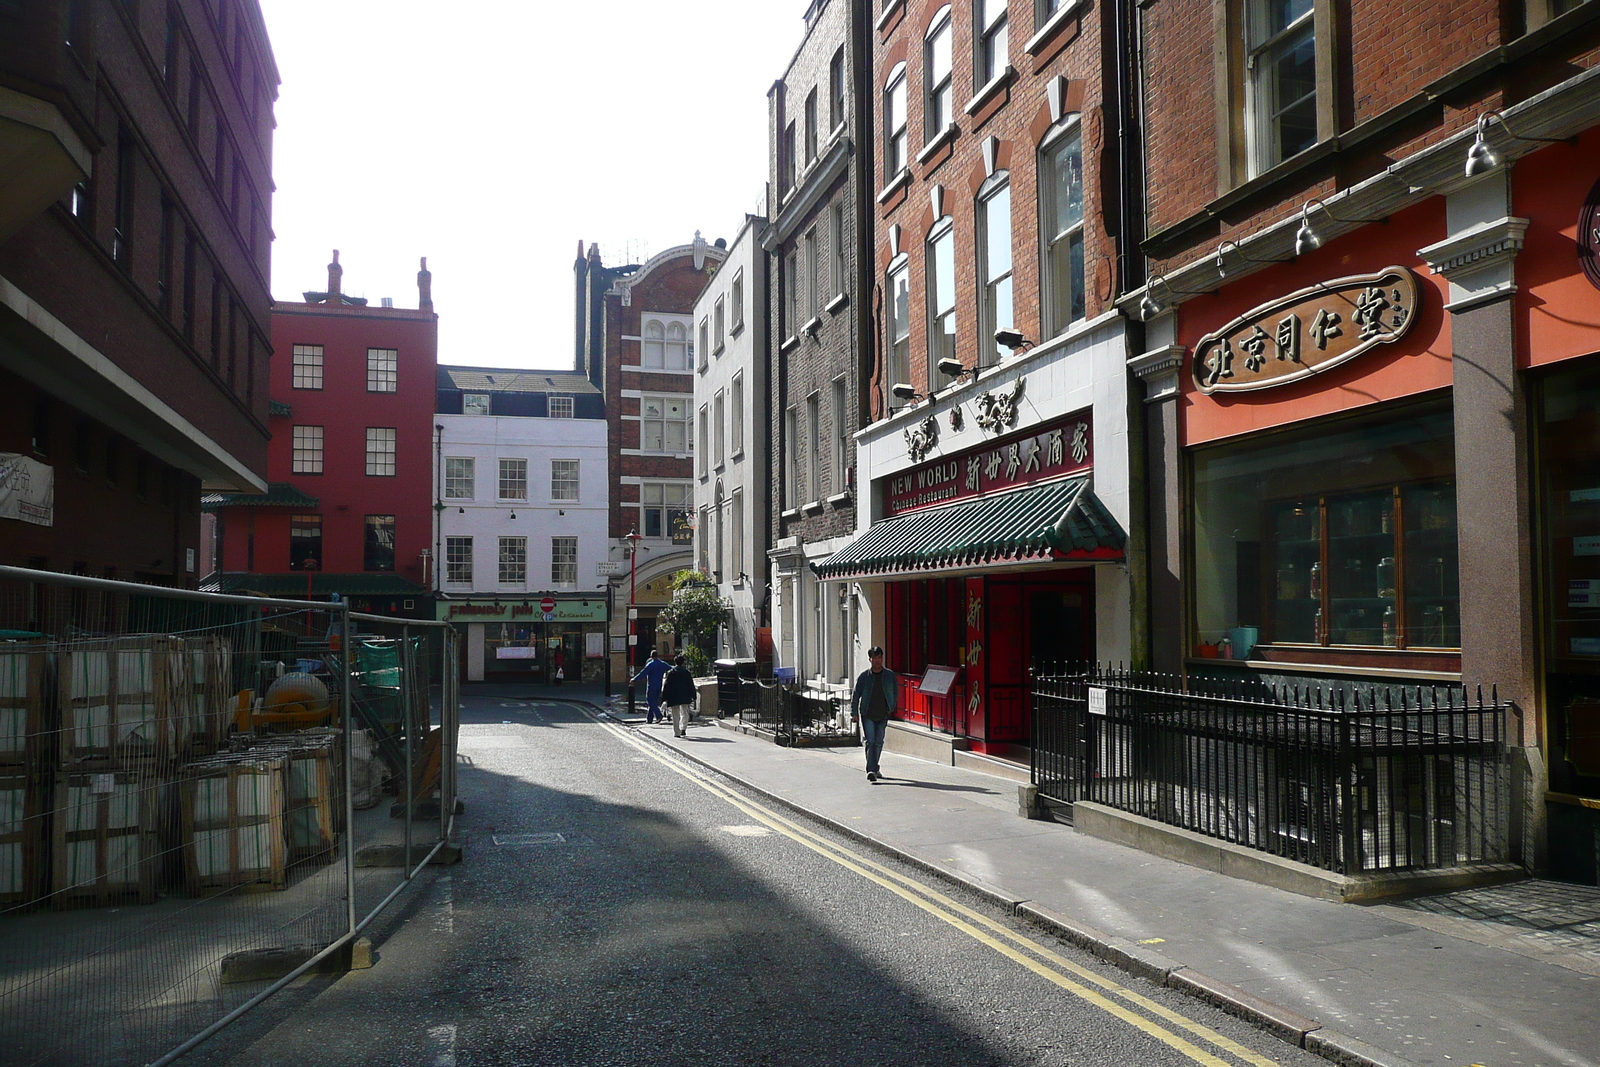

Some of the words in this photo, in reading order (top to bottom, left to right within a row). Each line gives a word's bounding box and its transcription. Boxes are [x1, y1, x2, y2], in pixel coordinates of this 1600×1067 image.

[1207, 286, 1385, 385] 北京同仁堂
[891, 474, 913, 496] NEW
[918, 461, 959, 489] WORLD
[965, 421, 1089, 492] 新世界大酒家
[891, 497, 917, 511] Chinese
[918, 484, 958, 505] Restaurant
[449, 605, 507, 619] FRIENDLY
[966, 590, 982, 716] 新世界
